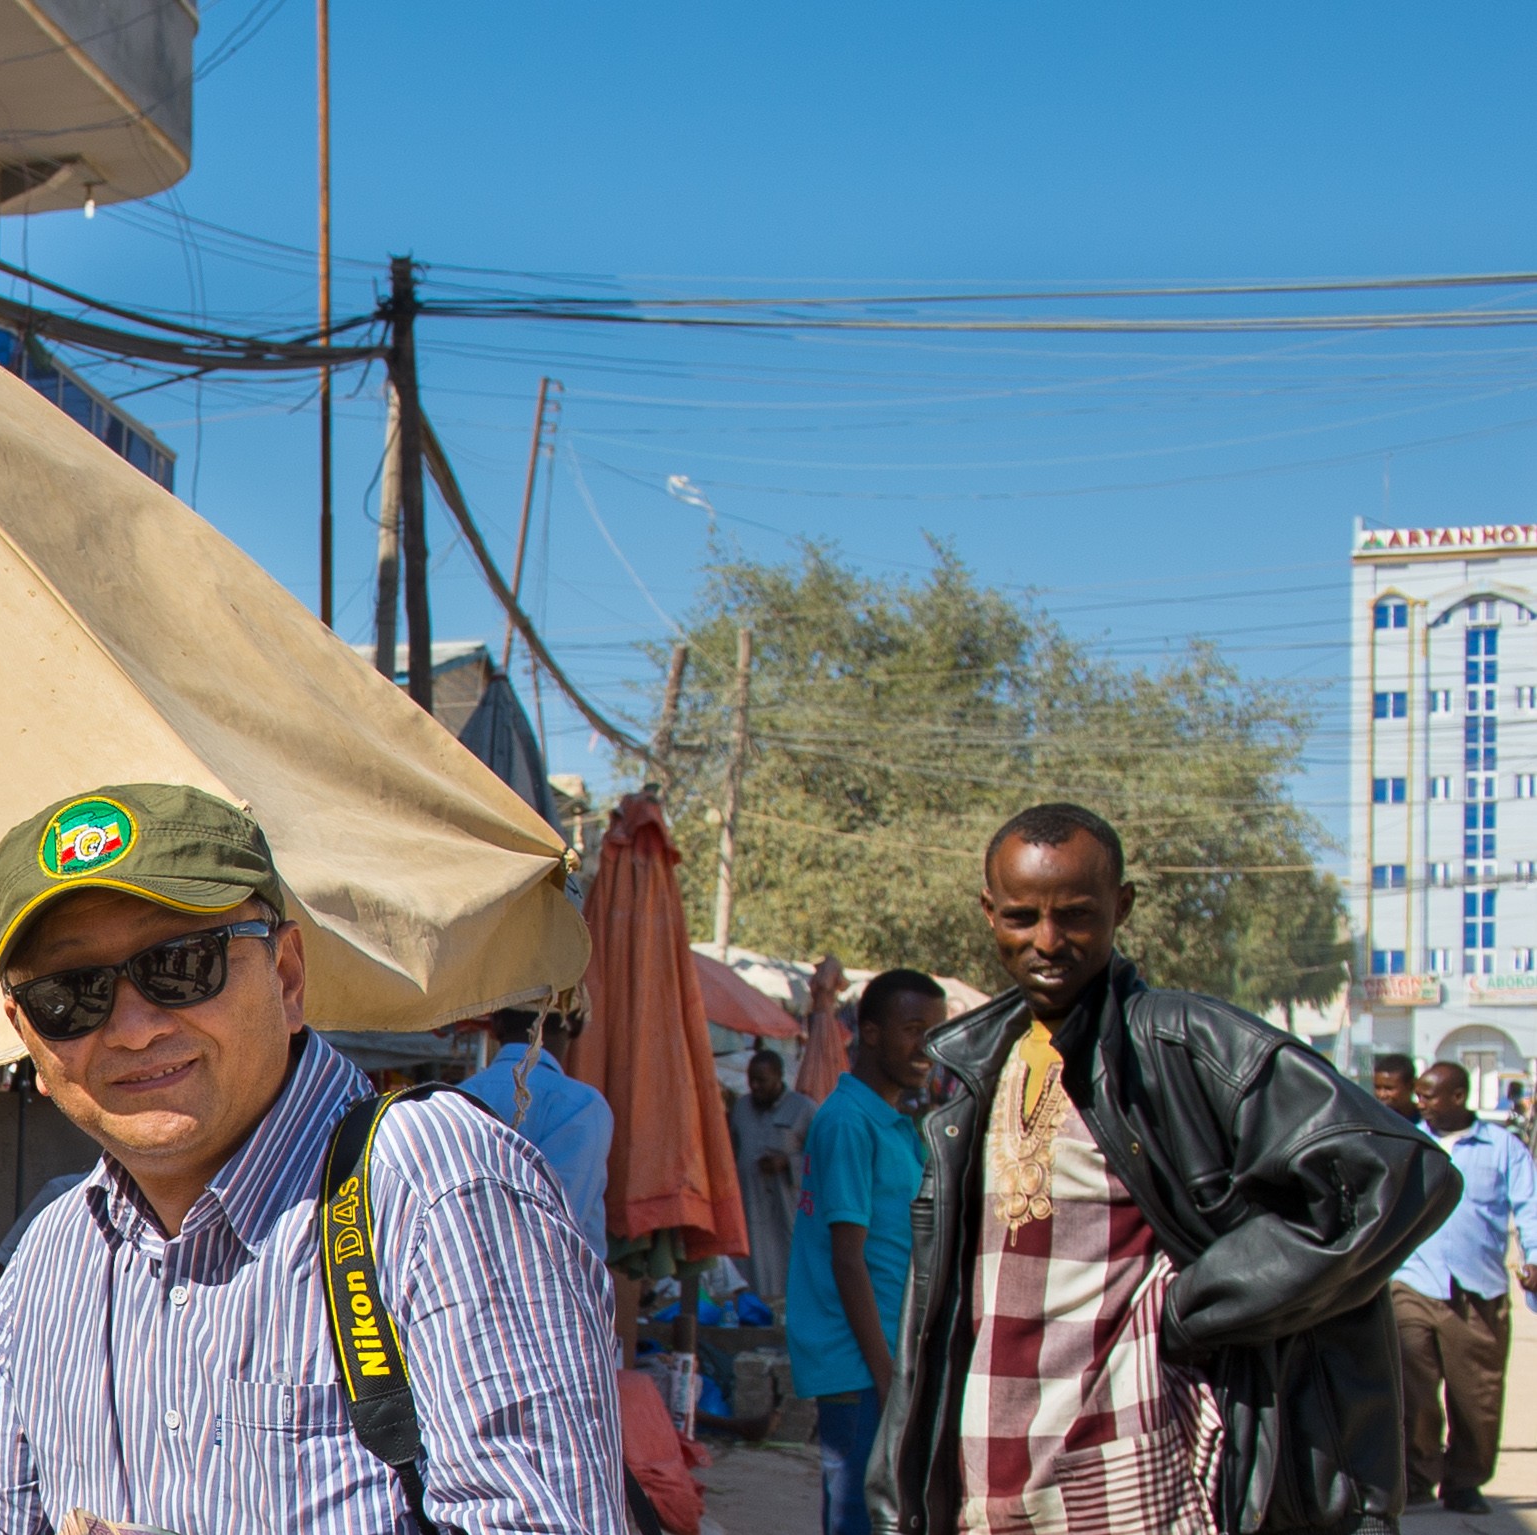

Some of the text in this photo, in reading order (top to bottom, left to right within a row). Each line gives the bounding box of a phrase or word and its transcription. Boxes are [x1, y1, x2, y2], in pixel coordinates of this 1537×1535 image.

[1388, 524, 1537, 548] ARTAN HOT
[1487, 974, 1537, 990] ABOKO
[332, 1176, 391, 1377] Nikon D4s
